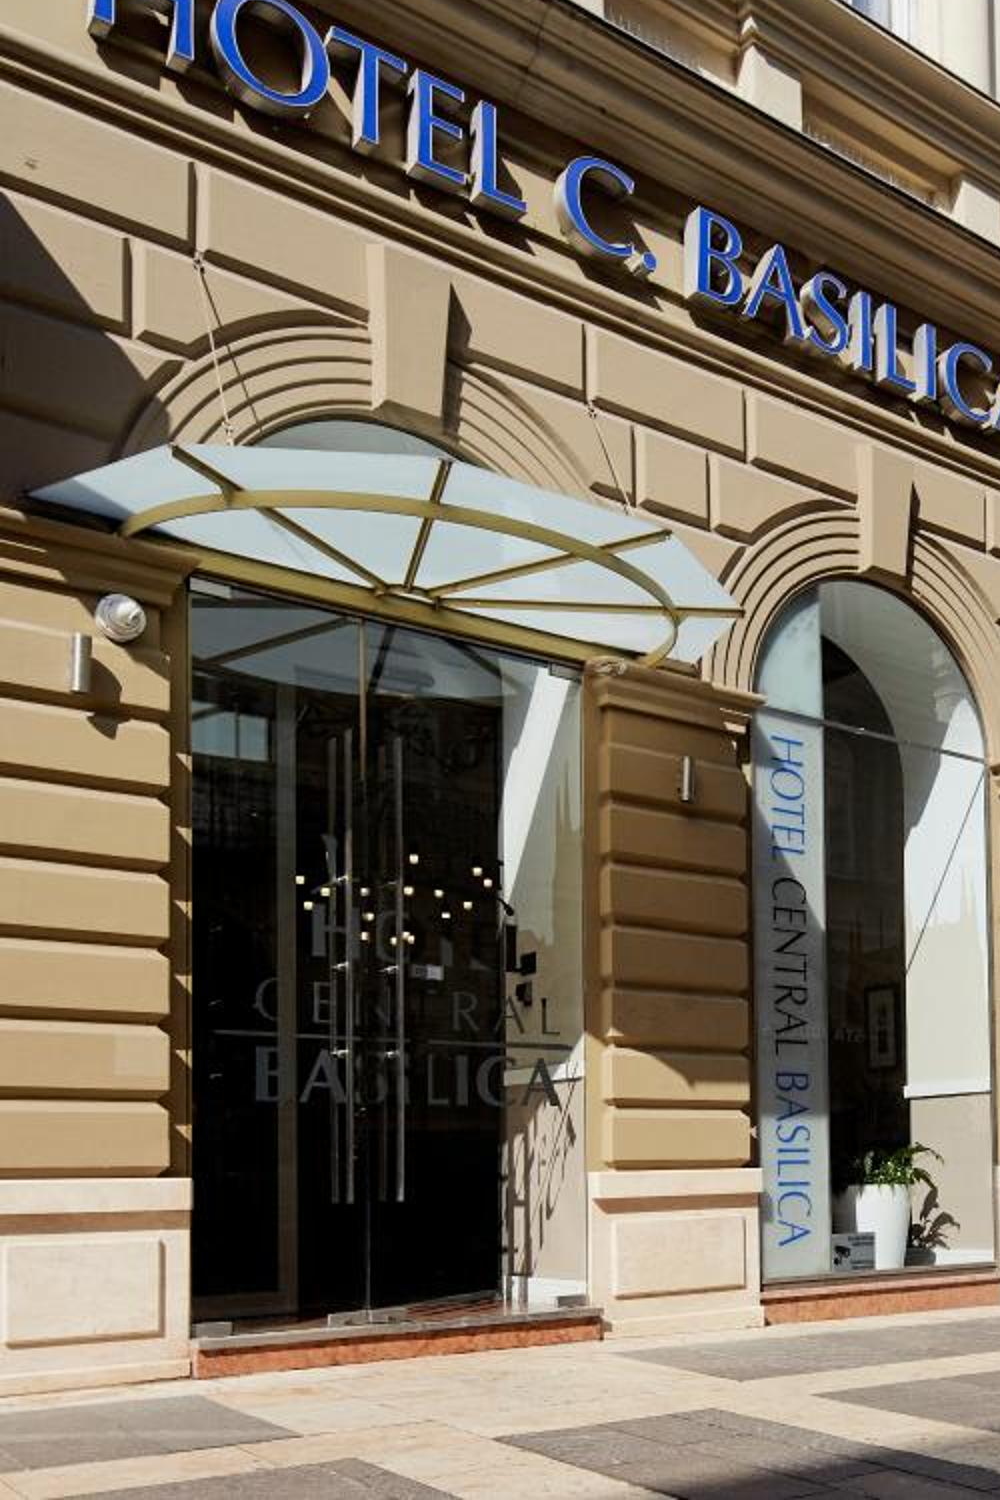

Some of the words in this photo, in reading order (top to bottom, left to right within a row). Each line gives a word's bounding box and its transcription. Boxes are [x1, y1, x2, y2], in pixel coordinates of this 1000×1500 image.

[553, 156, 657, 275] C.
[771, 735, 805, 860] HOTEL
[772, 877, 809, 1056] CENTRAL
[775, 1072, 813, 1247] BASILICA
